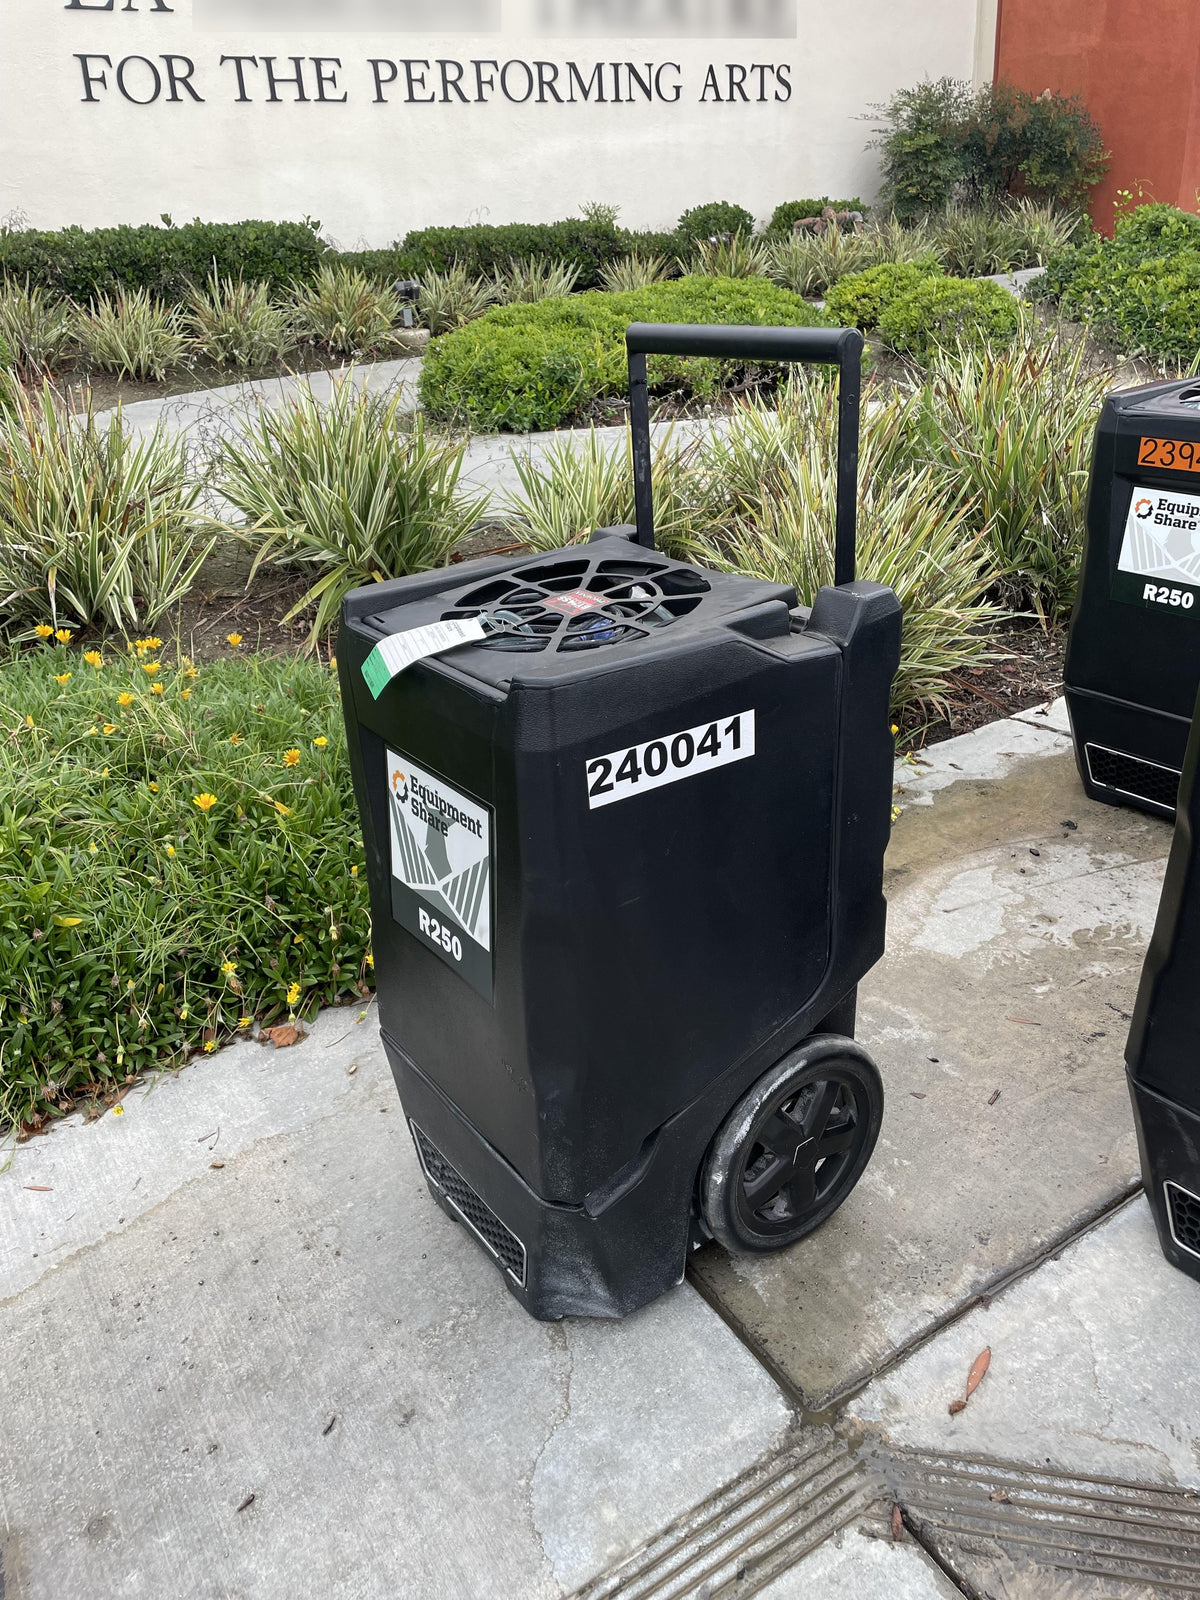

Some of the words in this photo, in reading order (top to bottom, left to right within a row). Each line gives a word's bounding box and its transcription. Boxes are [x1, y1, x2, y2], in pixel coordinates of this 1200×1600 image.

[73, 54, 205, 104] FOR
[219, 55, 347, 102] THE
[367, 59, 683, 103] PERFORMING
[698, 63, 792, 103] ARTS
[1153, 512, 1197, 531] Share
[1157, 498, 1200, 518] Equip
[1142, 583, 1194, 609] R250
[587, 715, 741, 798] 240041
[410, 774, 482, 839] Equipment
[411, 797, 448, 837] Share
[418, 906, 463, 962] R250
